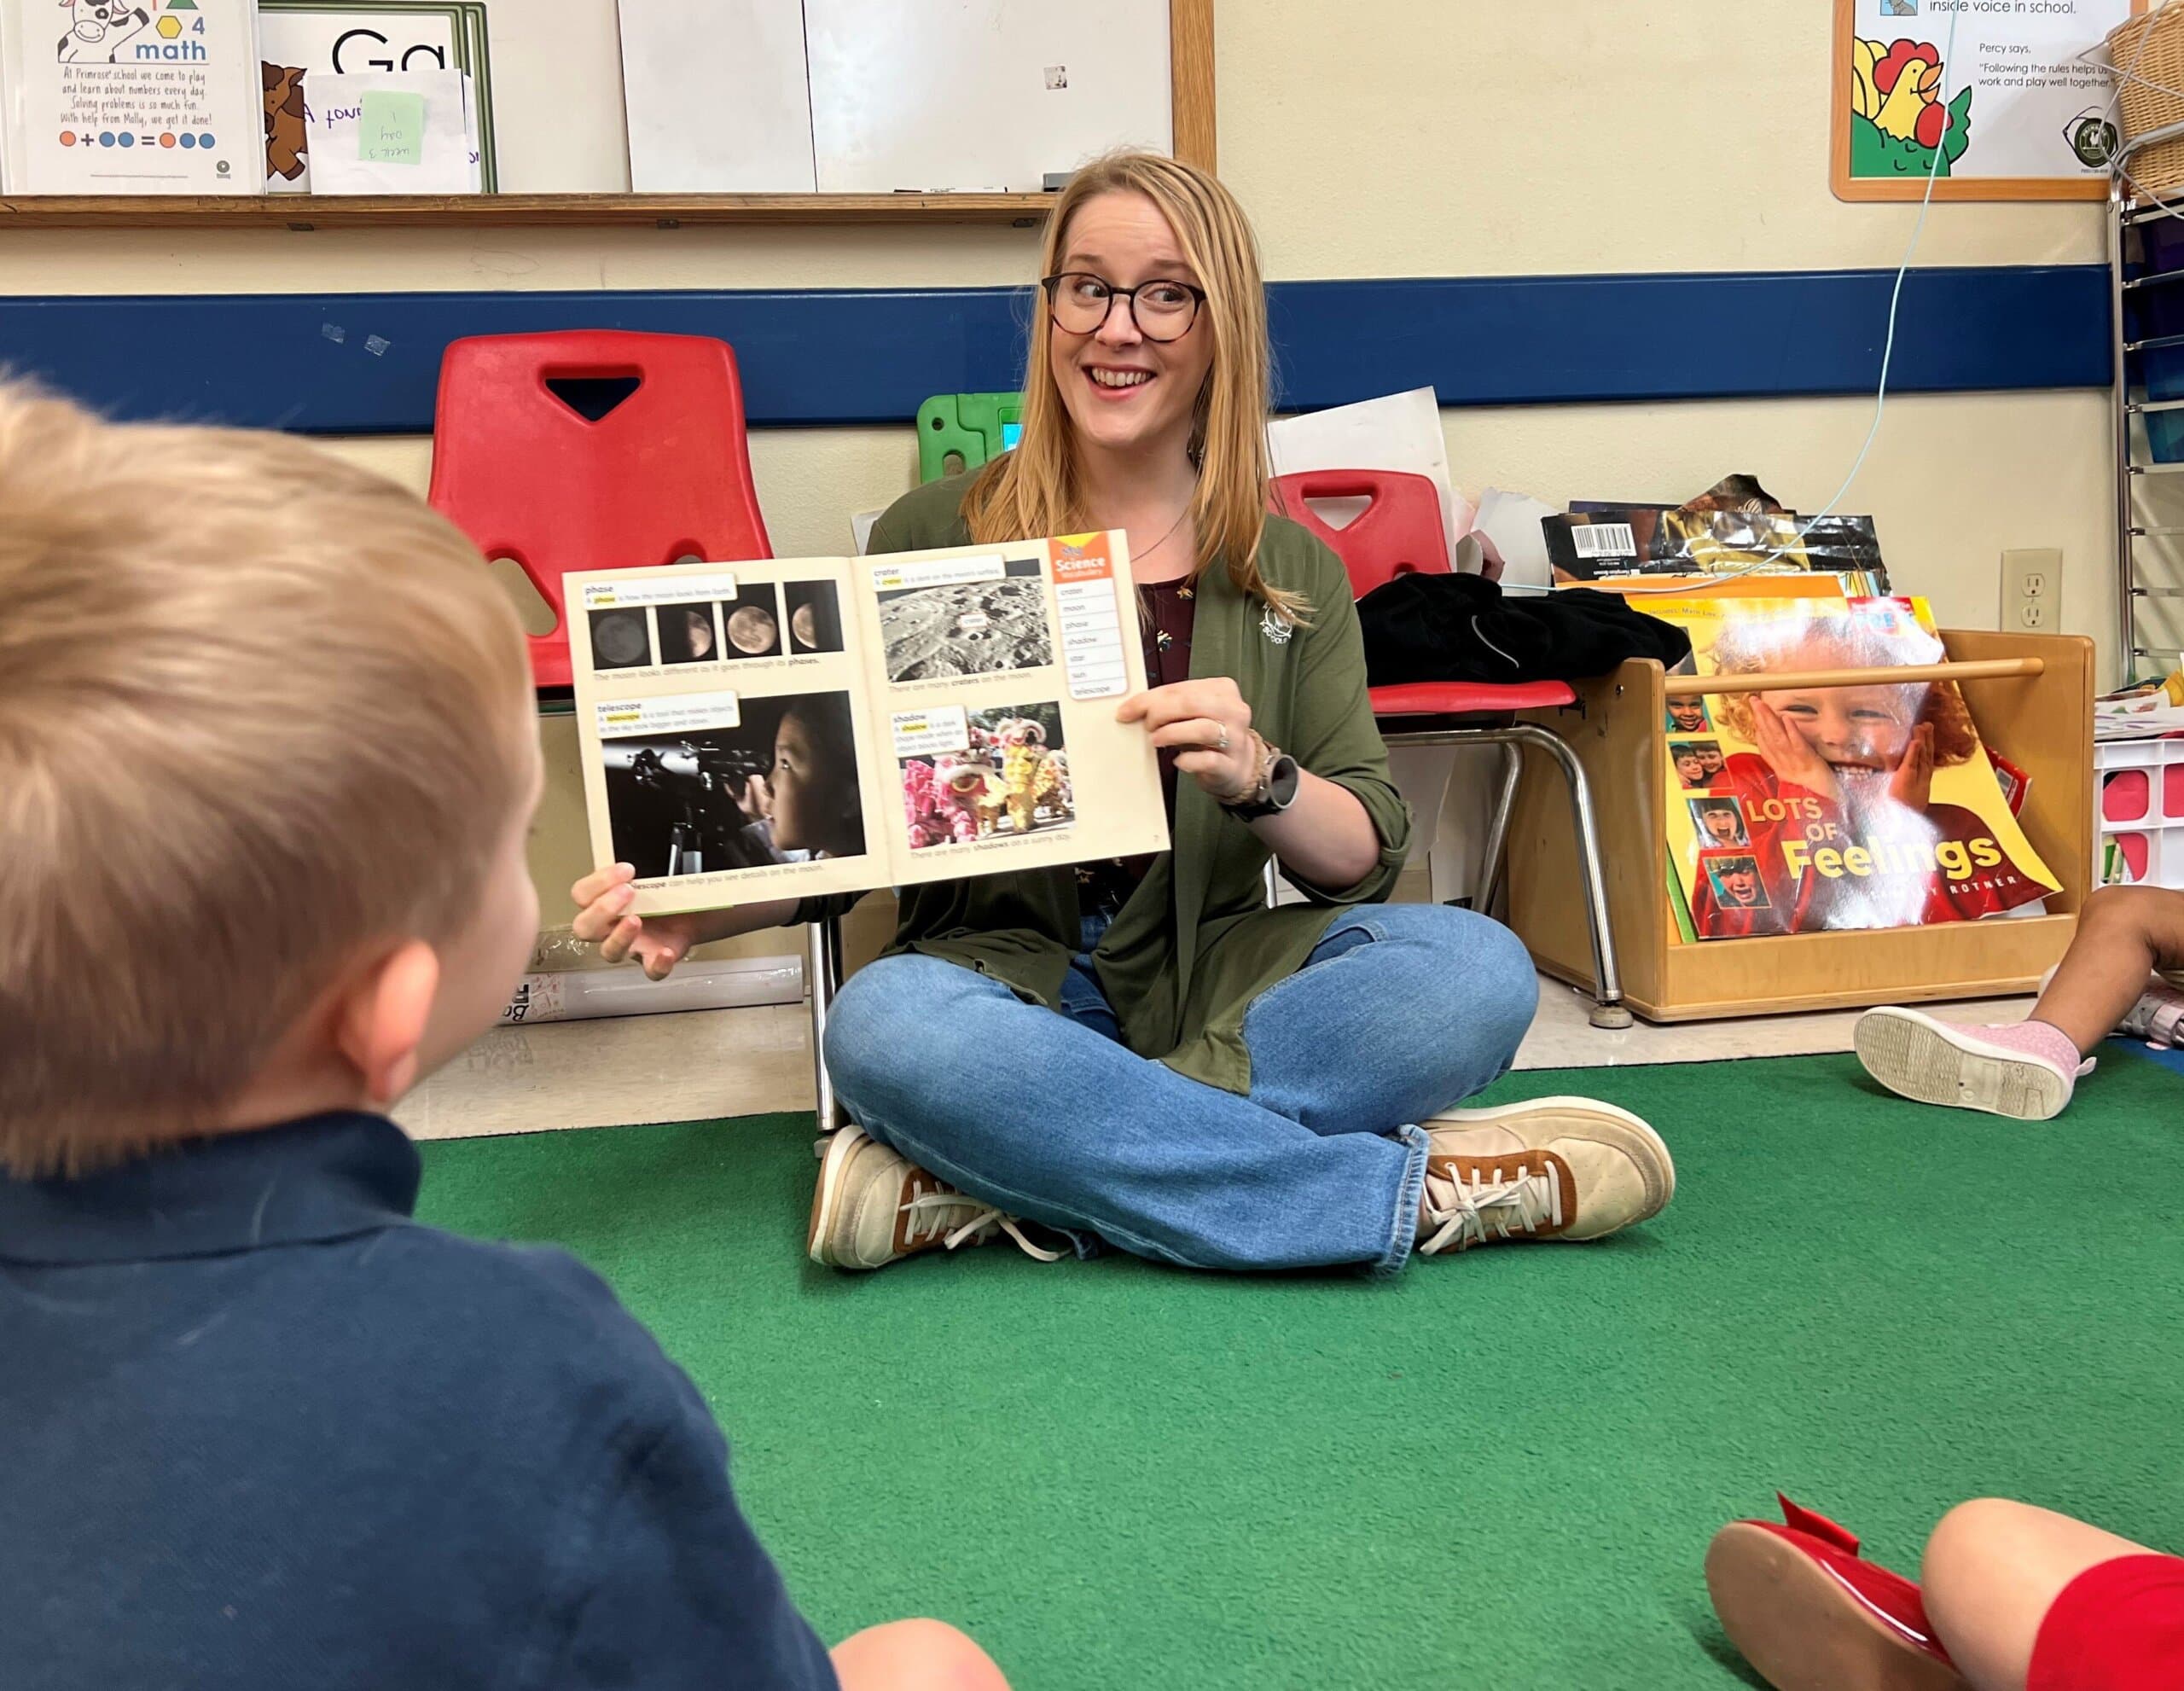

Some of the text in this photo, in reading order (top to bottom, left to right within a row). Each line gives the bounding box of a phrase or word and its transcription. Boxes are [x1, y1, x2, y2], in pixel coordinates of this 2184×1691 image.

[1973, 0, 2011, 13] voice
[2014, 0, 2026, 13] in
[192, 16, 205, 35] 4
[136, 40, 206, 61] math
[1979, 43, 2031, 55] Percy says,
[63, 66, 73, 79] At
[113, 68, 137, 80] school
[141, 72, 152, 80] we
[155, 71, 175, 81] come
[178, 70, 185, 81] to
[189, 70, 206, 85] play
[2031, 63, 2046, 73] the
[2048, 64, 2070, 74] rules
[2072, 64, 2096, 76] helps
[2098, 67, 2108, 75] us
[62, 84, 77, 95] and
[80, 82, 101, 95] learn
[104, 84, 125, 95] about
[129, 84, 161, 96] numbers
[164, 86, 186, 100] every
[1978, 77, 2001, 86] work
[2004, 78, 2024, 87] and
[2026, 78, 2047, 88] play
[2048, 78, 2067, 87] well
[71, 96, 98, 113] Solving
[102, 97, 136, 112] problems
[139, 100, 145, 110] is
[148, 101, 157, 110] so
[161, 100, 181, 111] much
[61, 112, 78, 124] With
[82, 112, 98, 127] help
[102, 113, 120, 125] from
[151, 116, 163, 125] we
[166, 113, 178, 129] get
[182, 113, 188, 125] it
[191, 113, 213, 126] done!
[1054, 557, 1107, 572] Science
[585, 584, 614, 596] phase
[597, 702, 642, 713] telescope
[1746, 797, 1823, 822] LOTS
[1805, 822, 1838, 842] OF
[1780, 835, 2002, 880] Feelings
[1949, 875, 2017, 895] ROTNER
